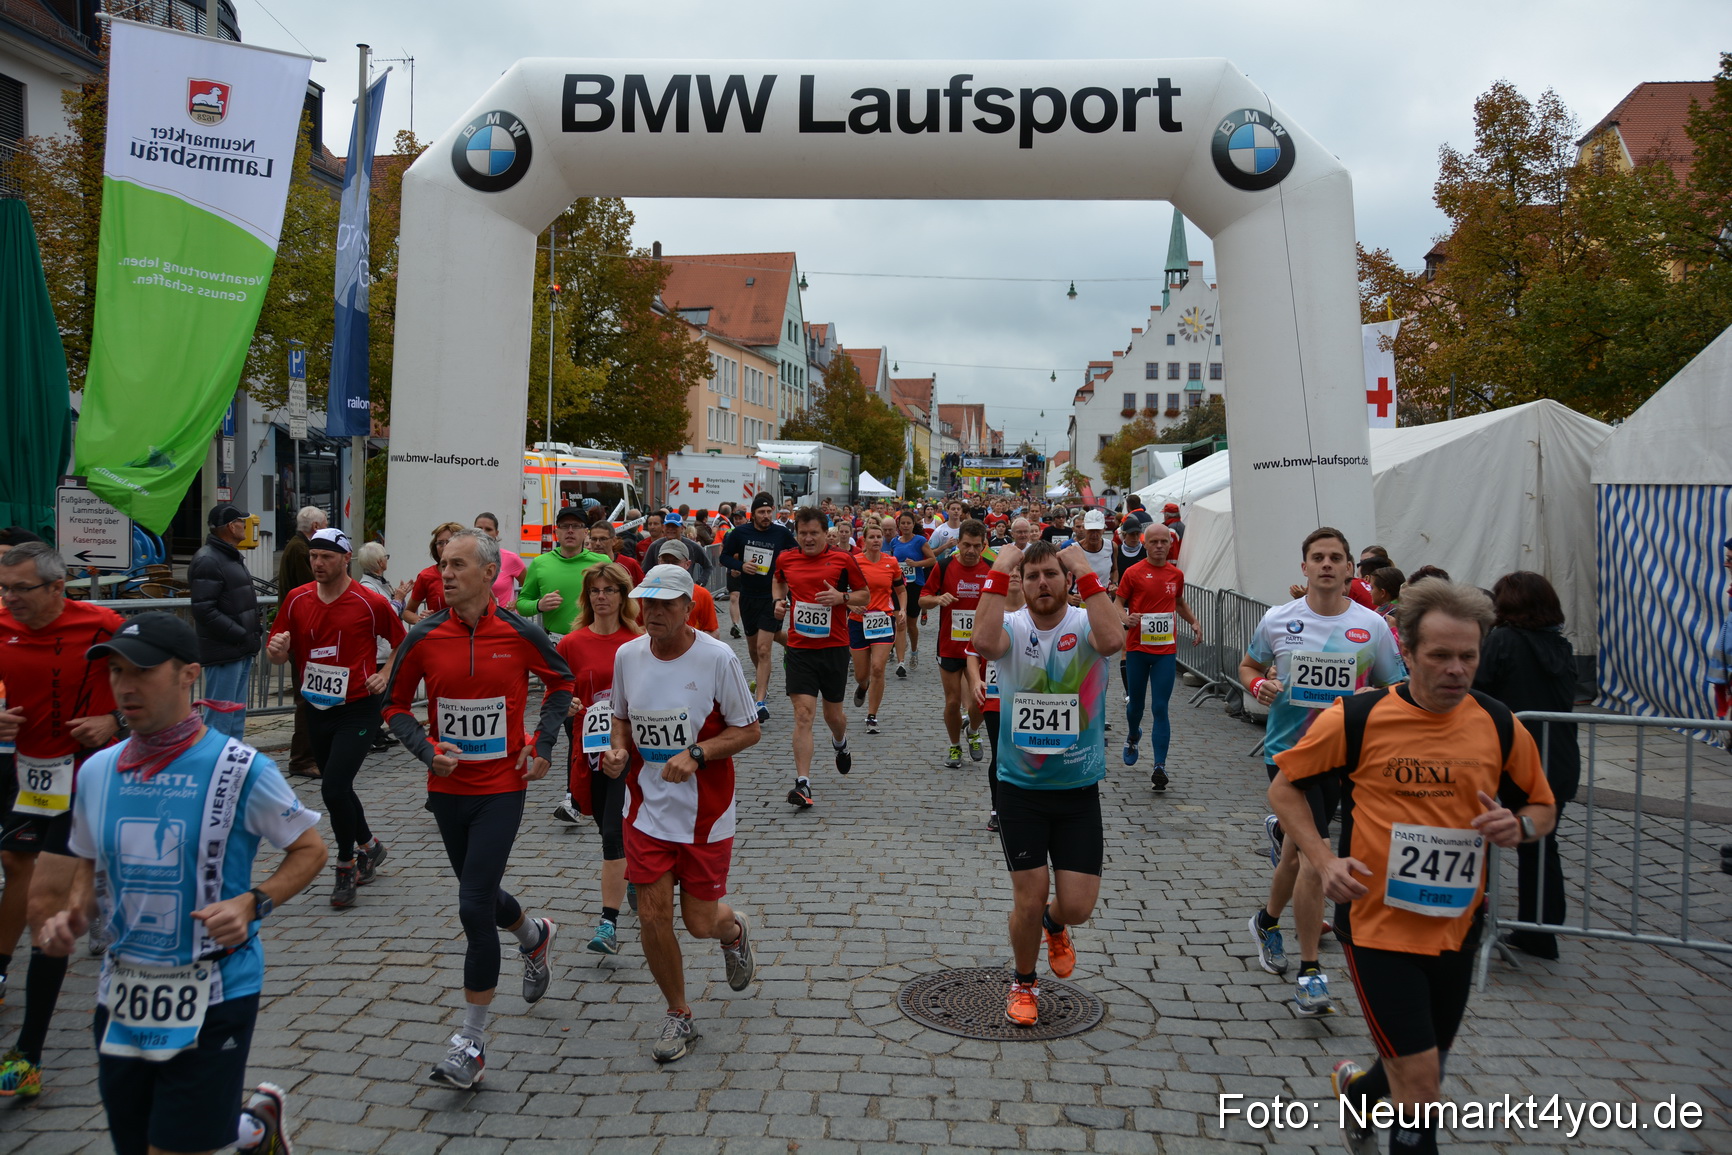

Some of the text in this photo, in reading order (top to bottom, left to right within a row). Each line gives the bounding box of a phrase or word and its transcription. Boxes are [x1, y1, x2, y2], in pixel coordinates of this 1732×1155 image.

[561, 74, 1184, 149] BMW Laufsport
[462, 112, 526, 138] BMW
[1219, 110, 1286, 137] BMW
[252, 450, 258, 464] 3
[390, 452, 500, 468] www.bmw-laufsport.de
[1253, 454, 1369, 470] www.bmw-laufsport.de
[61, 496, 97, 505] Fußgänger
[72, 506, 117, 514] Lammsbräu-
[70, 516, 102, 525] Kreuzung
[72, 536, 117, 545] Kaserngasse
[752, 554, 764, 564] 58
[797, 610, 828, 626] 2363
[866, 618, 889, 629] 2224
[959, 618, 973, 630] 18
[1148, 621, 1169, 633] 308
[307, 674, 342, 694] 2043
[990, 670, 997, 684] 2
[1297, 664, 1350, 688] 2505
[312, 695, 331, 704] Robert
[439, 702, 459, 711] PARTL
[444, 713, 500, 737] 2107
[588, 714, 613, 733] 25
[1018, 709, 1071, 731] 2541
[637, 724, 686, 746] 2514
[1029, 735, 1061, 746] Markus
[457, 742, 487, 752] Robert
[1388, 757, 1420, 766] OPTIK
[27, 769, 53, 791] 68
[121, 772, 199, 788] VIERTL
[1395, 766, 1456, 784] OEXL
[119, 787, 198, 799] DESIGN GmbH
[209, 765, 235, 828] VIERTL
[1394, 831, 1472, 847] PARTL Neumarkt
[1398, 846, 1476, 883] 2474
[1419, 889, 1452, 904] Franz
[139, 971, 191, 980] Neumarkt
[114, 983, 198, 1021] 2668
